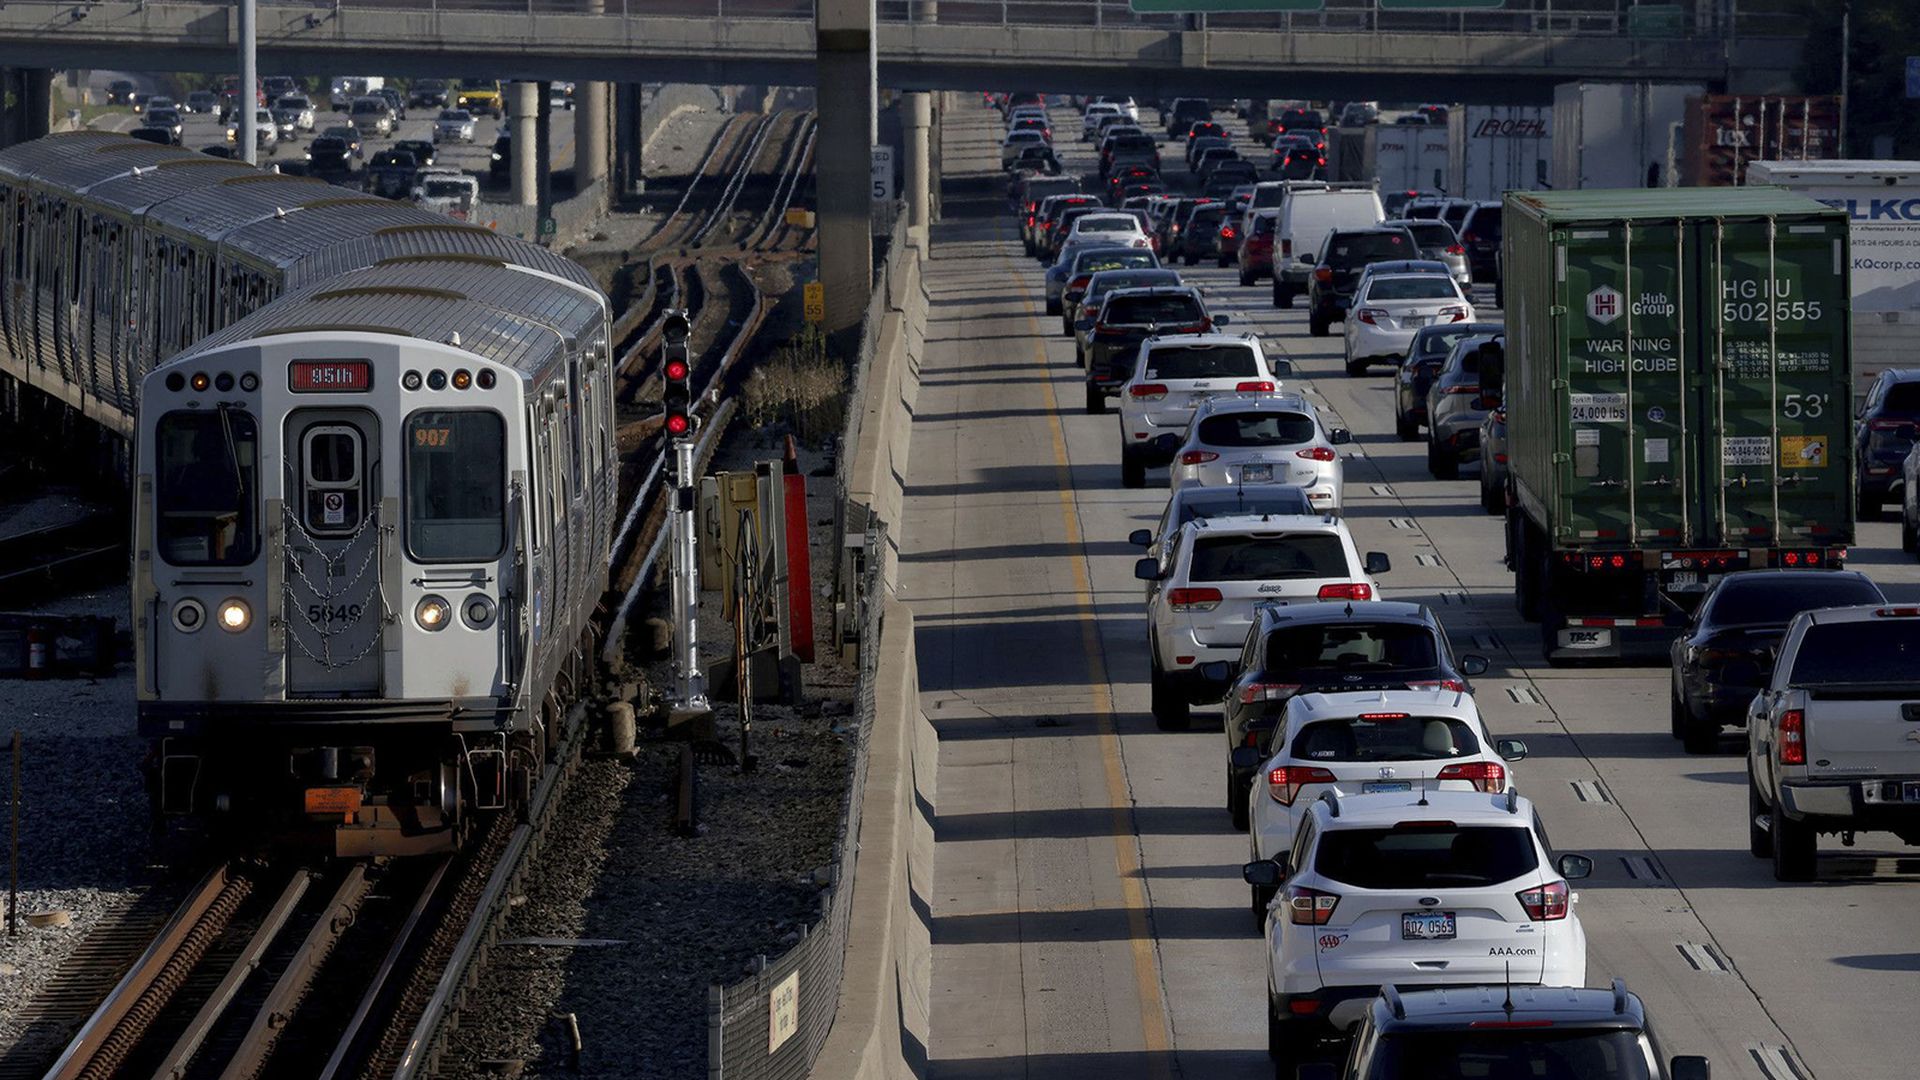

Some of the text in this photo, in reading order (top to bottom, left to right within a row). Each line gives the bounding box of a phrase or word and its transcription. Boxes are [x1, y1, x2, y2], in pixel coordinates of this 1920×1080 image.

[873, 181, 886, 198] 5
[1851, 258, 1920, 271] KQcorp.co
[1640, 292, 1668, 305] Hub
[1631, 302, 1676, 318] Group
[1723, 302, 1822, 321] 502555
[1586, 338, 1672, 353] WARNING
[1585, 358, 1678, 373] HIGH CUBE
[1609, 407, 1626, 419] lbs
[415, 428, 450, 446] 907
[1257, 584, 1282, 594] Jeep
[309, 604, 361, 622] 5649
[1569, 631, 1600, 642] TRAC
[1489, 947, 1536, 956] AAA.com
